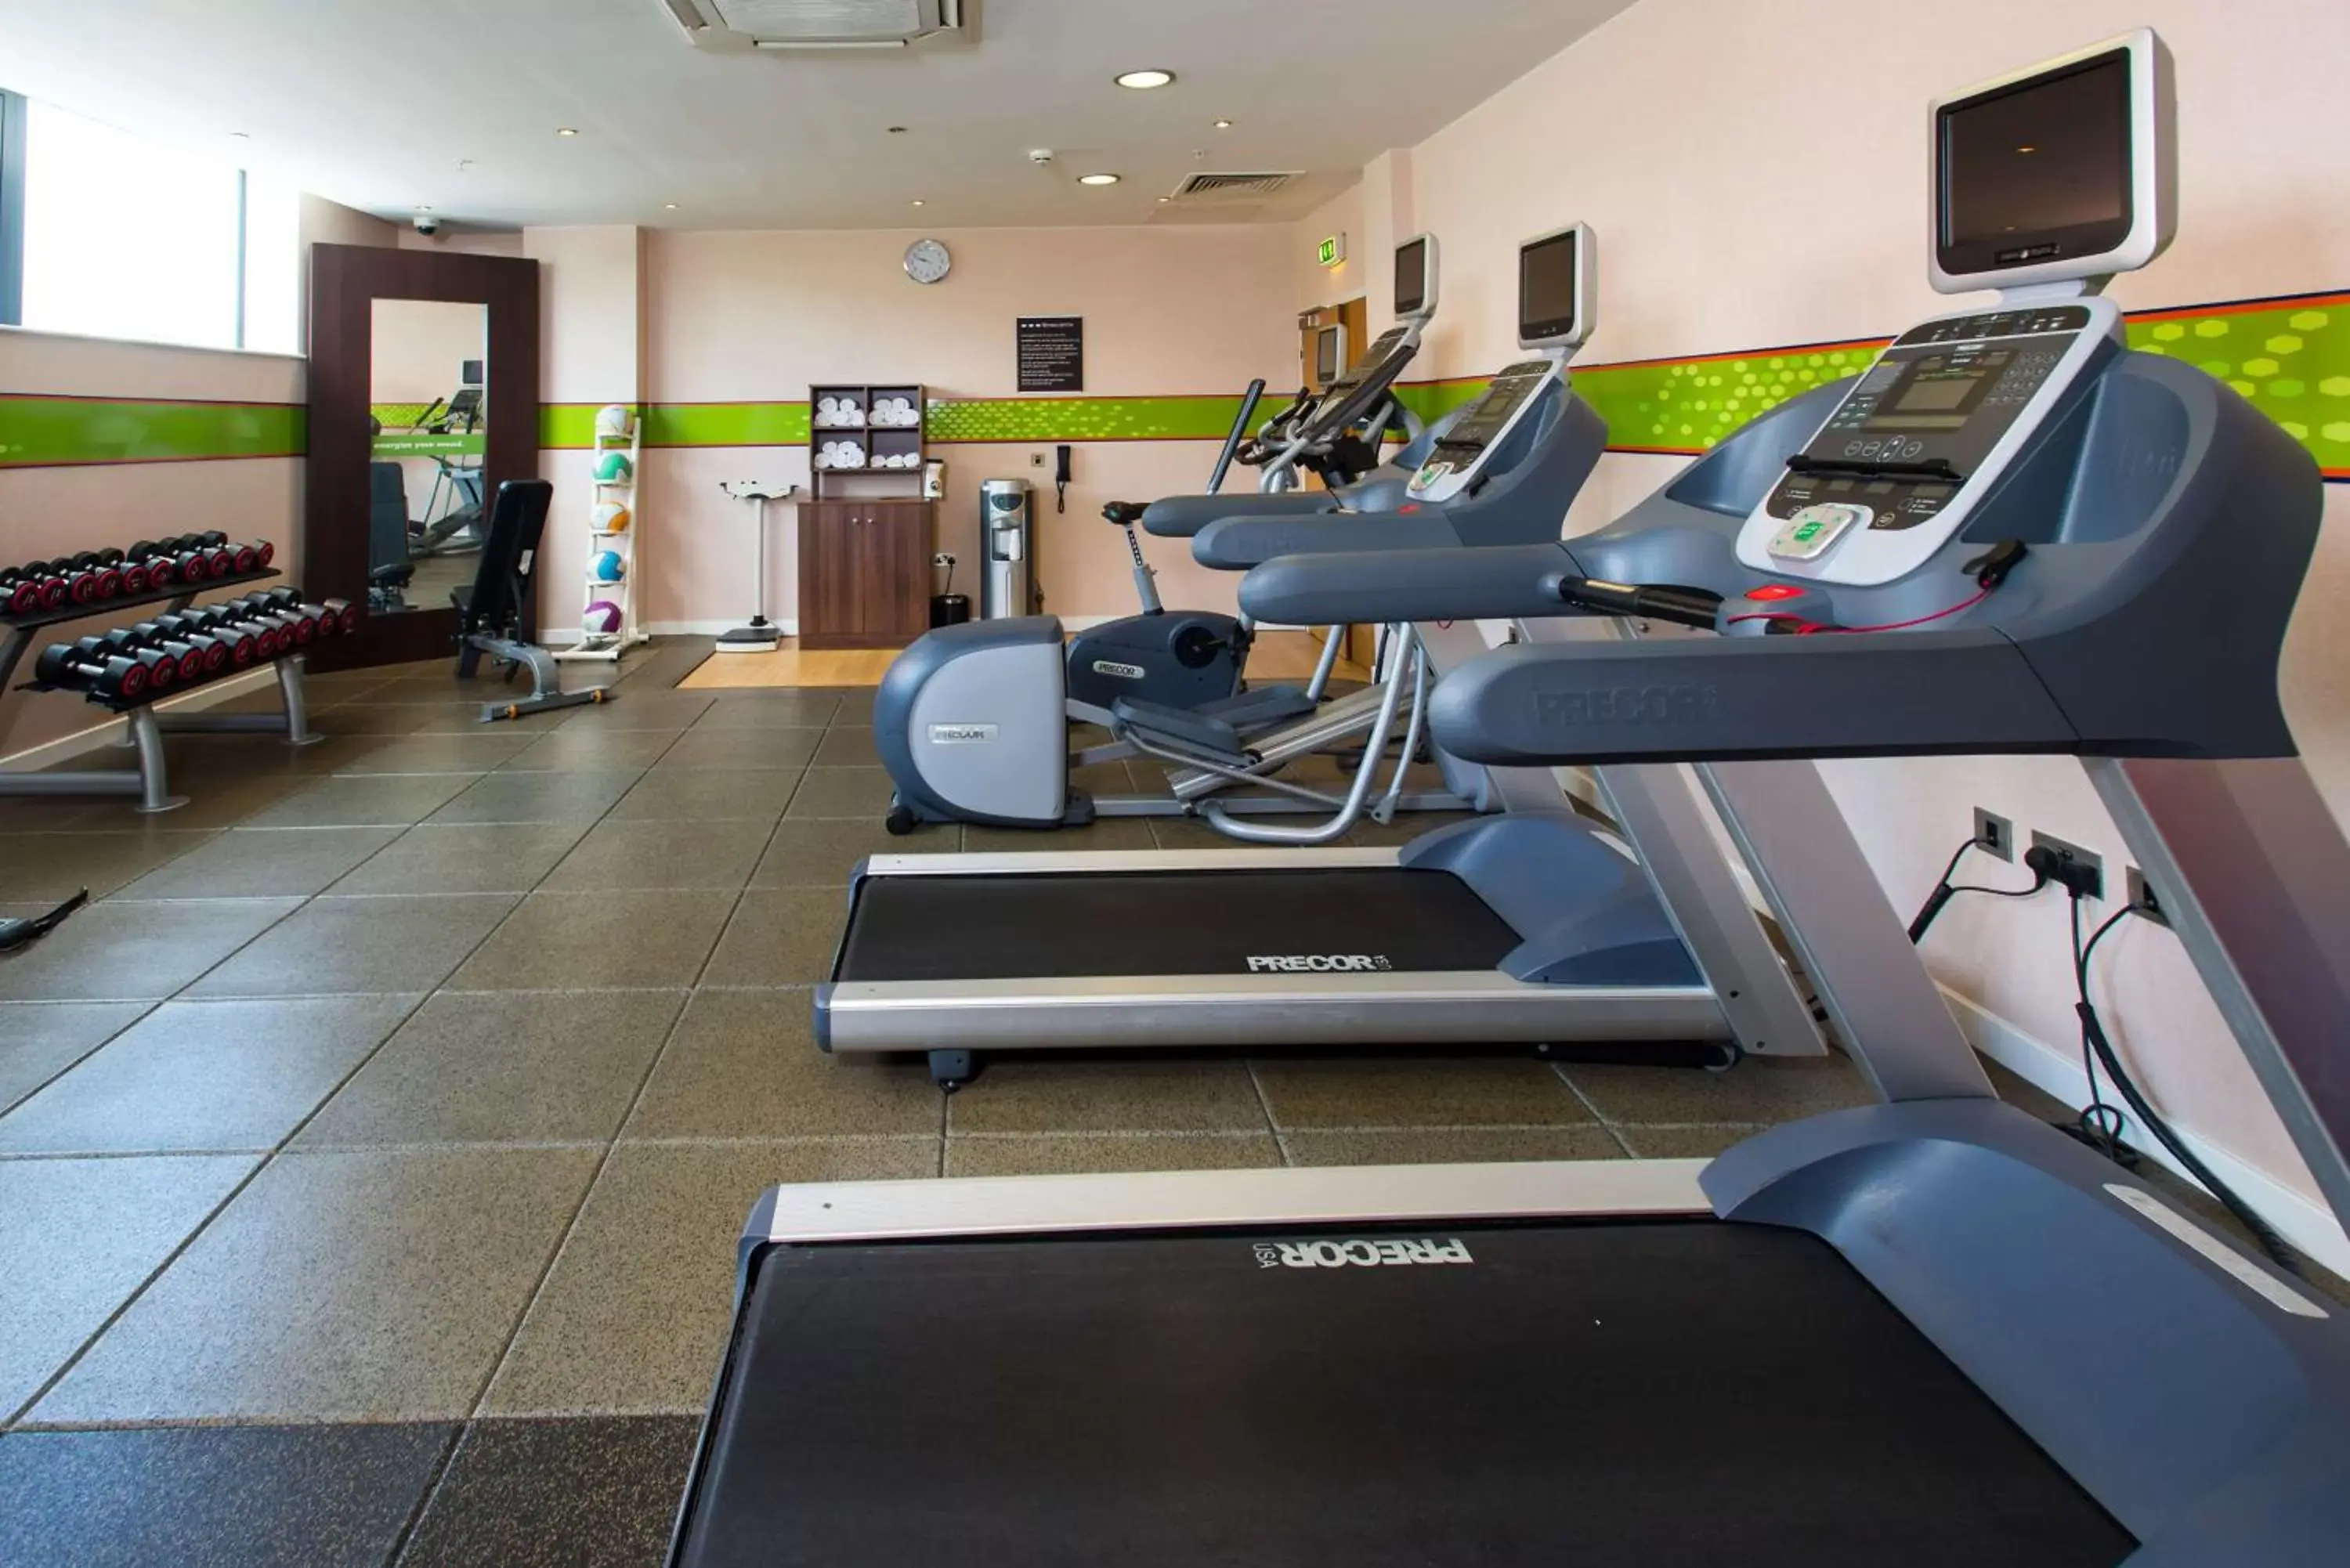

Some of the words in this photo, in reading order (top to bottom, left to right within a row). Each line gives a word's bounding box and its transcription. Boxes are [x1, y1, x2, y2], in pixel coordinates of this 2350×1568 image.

[1098, 663, 1135, 675] PRECOR
[1246, 954, 1377, 972] PRECOR
[1252, 1242, 1279, 1269] USA
[1274, 1237, 1473, 1268] PRECOR
